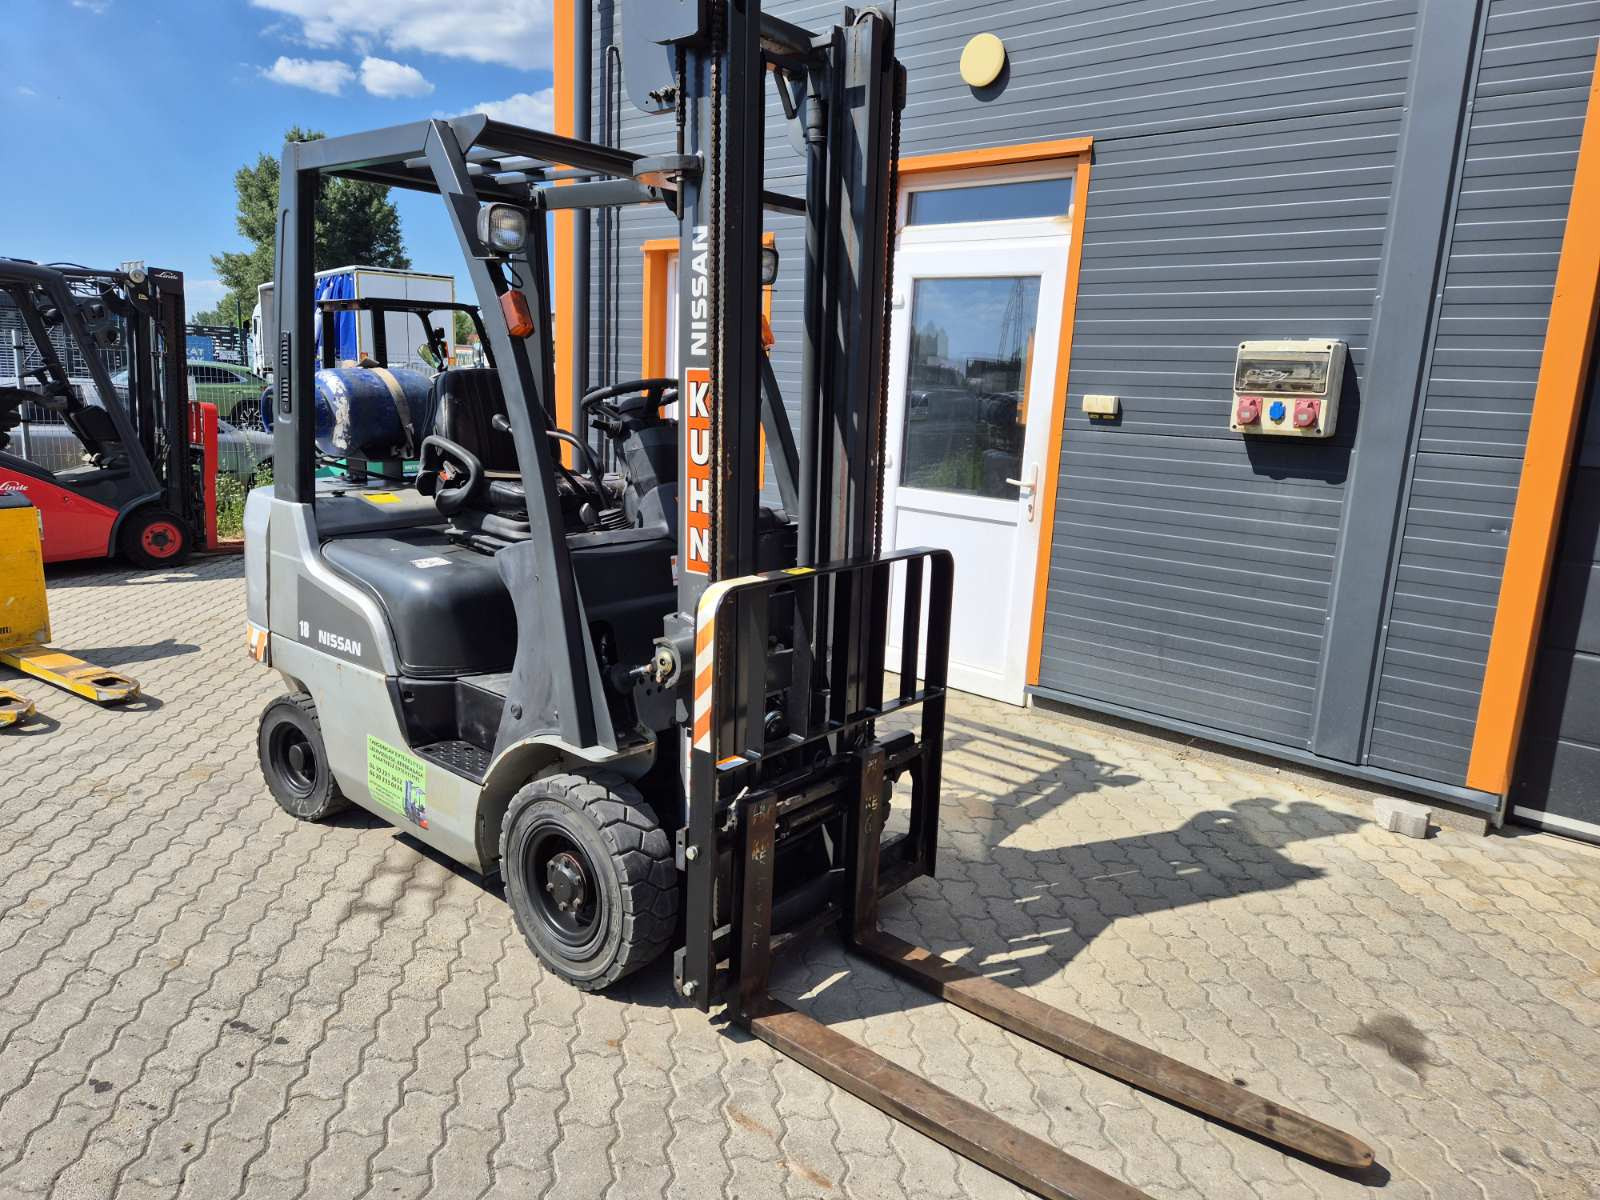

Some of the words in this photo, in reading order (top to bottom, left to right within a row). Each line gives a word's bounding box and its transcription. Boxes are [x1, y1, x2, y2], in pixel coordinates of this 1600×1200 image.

[153, 271, 179, 280] Linde
[690, 225, 709, 357] NISSAN
[689, 380, 710, 562] KUHN
[318, 629, 362, 657] NISSAN
